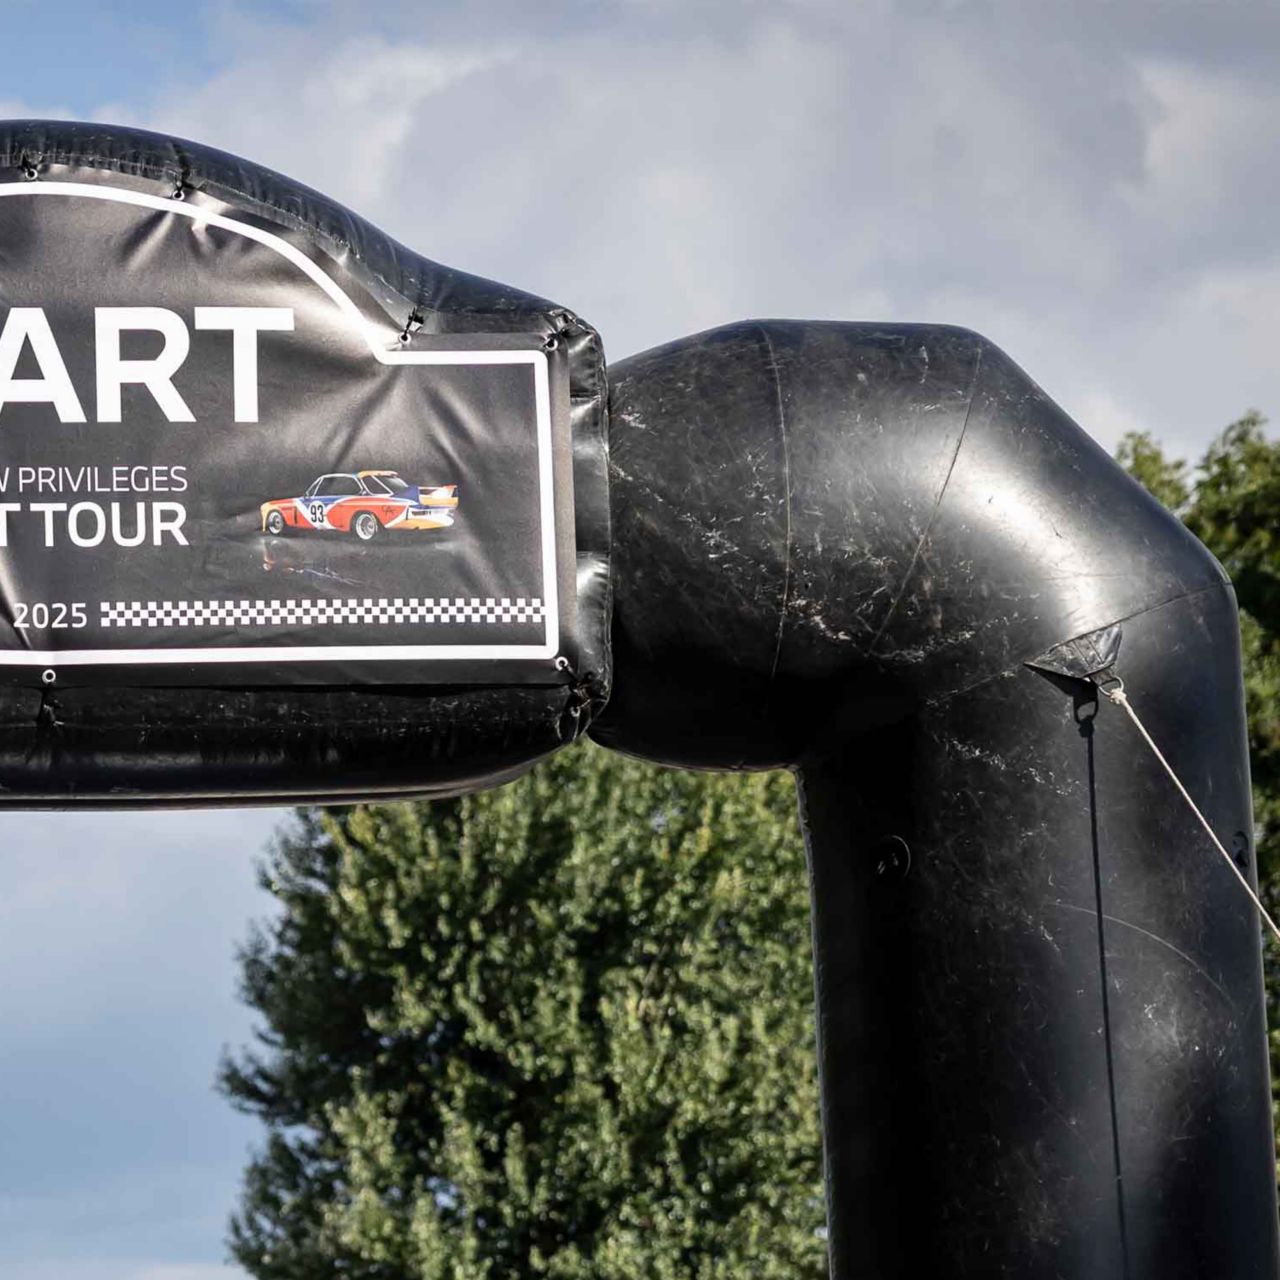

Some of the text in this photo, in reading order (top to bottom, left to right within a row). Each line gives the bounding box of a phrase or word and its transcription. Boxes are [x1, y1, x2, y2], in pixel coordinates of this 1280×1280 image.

[18, 465, 188, 493] PRIVILEGES
[30, 501, 190, 548] TOUR
[311, 504, 324, 523] 93
[13, 602, 88, 629] 2025
